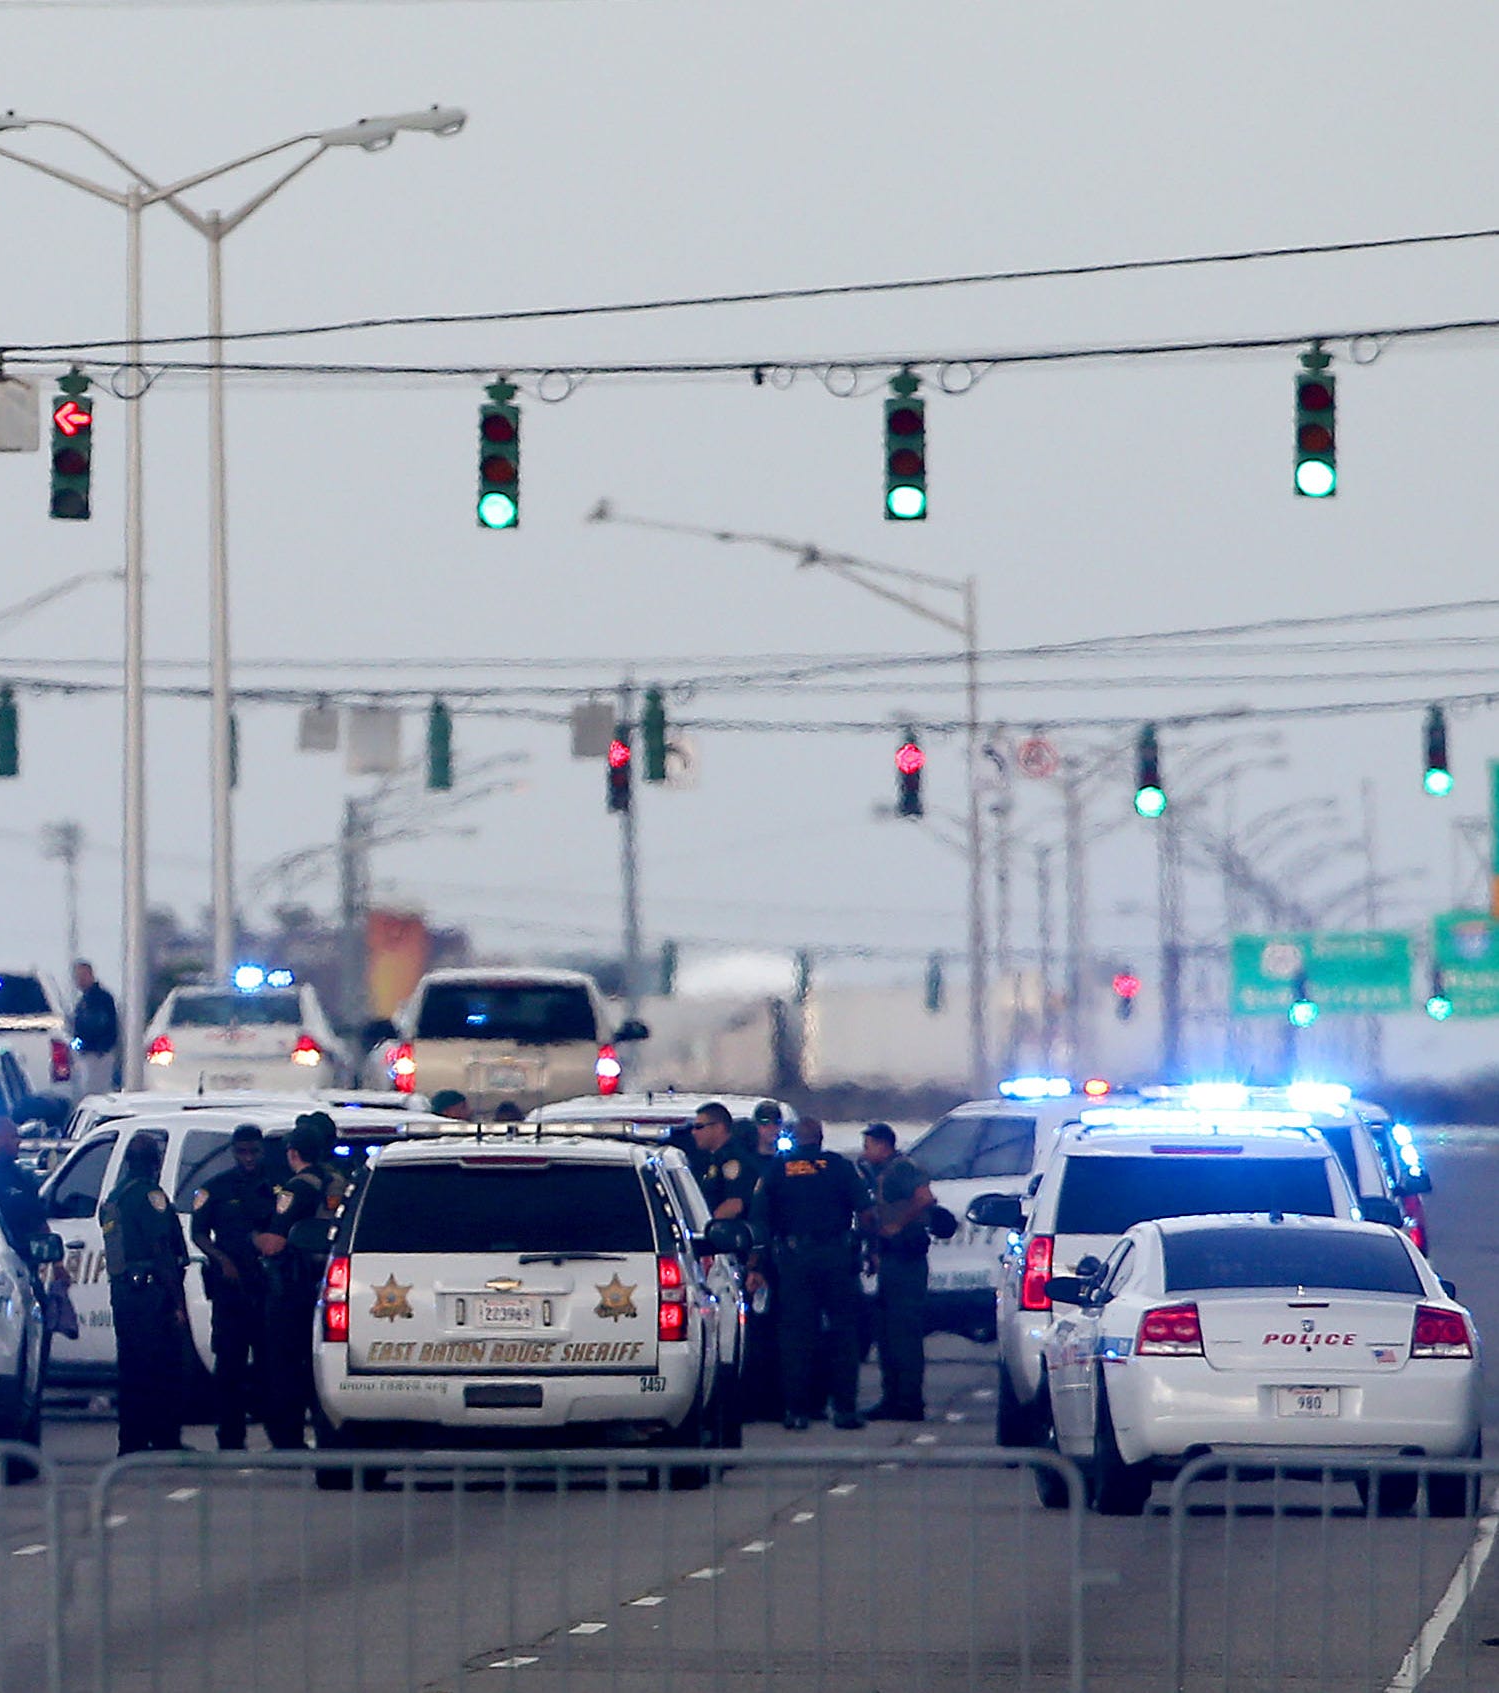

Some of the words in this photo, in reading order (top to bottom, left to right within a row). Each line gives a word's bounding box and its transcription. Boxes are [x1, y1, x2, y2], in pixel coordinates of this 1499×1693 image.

[1262, 1333, 1358, 1347] POLICE
[368, 1341, 417, 1363] EAST
[418, 1341, 486, 1364] BATON
[488, 1342, 557, 1364] ROUGE
[559, 1342, 645, 1362] SHERIFF
[639, 1376, 667, 1393] 3457
[1296, 1396, 1322, 1410] 980
